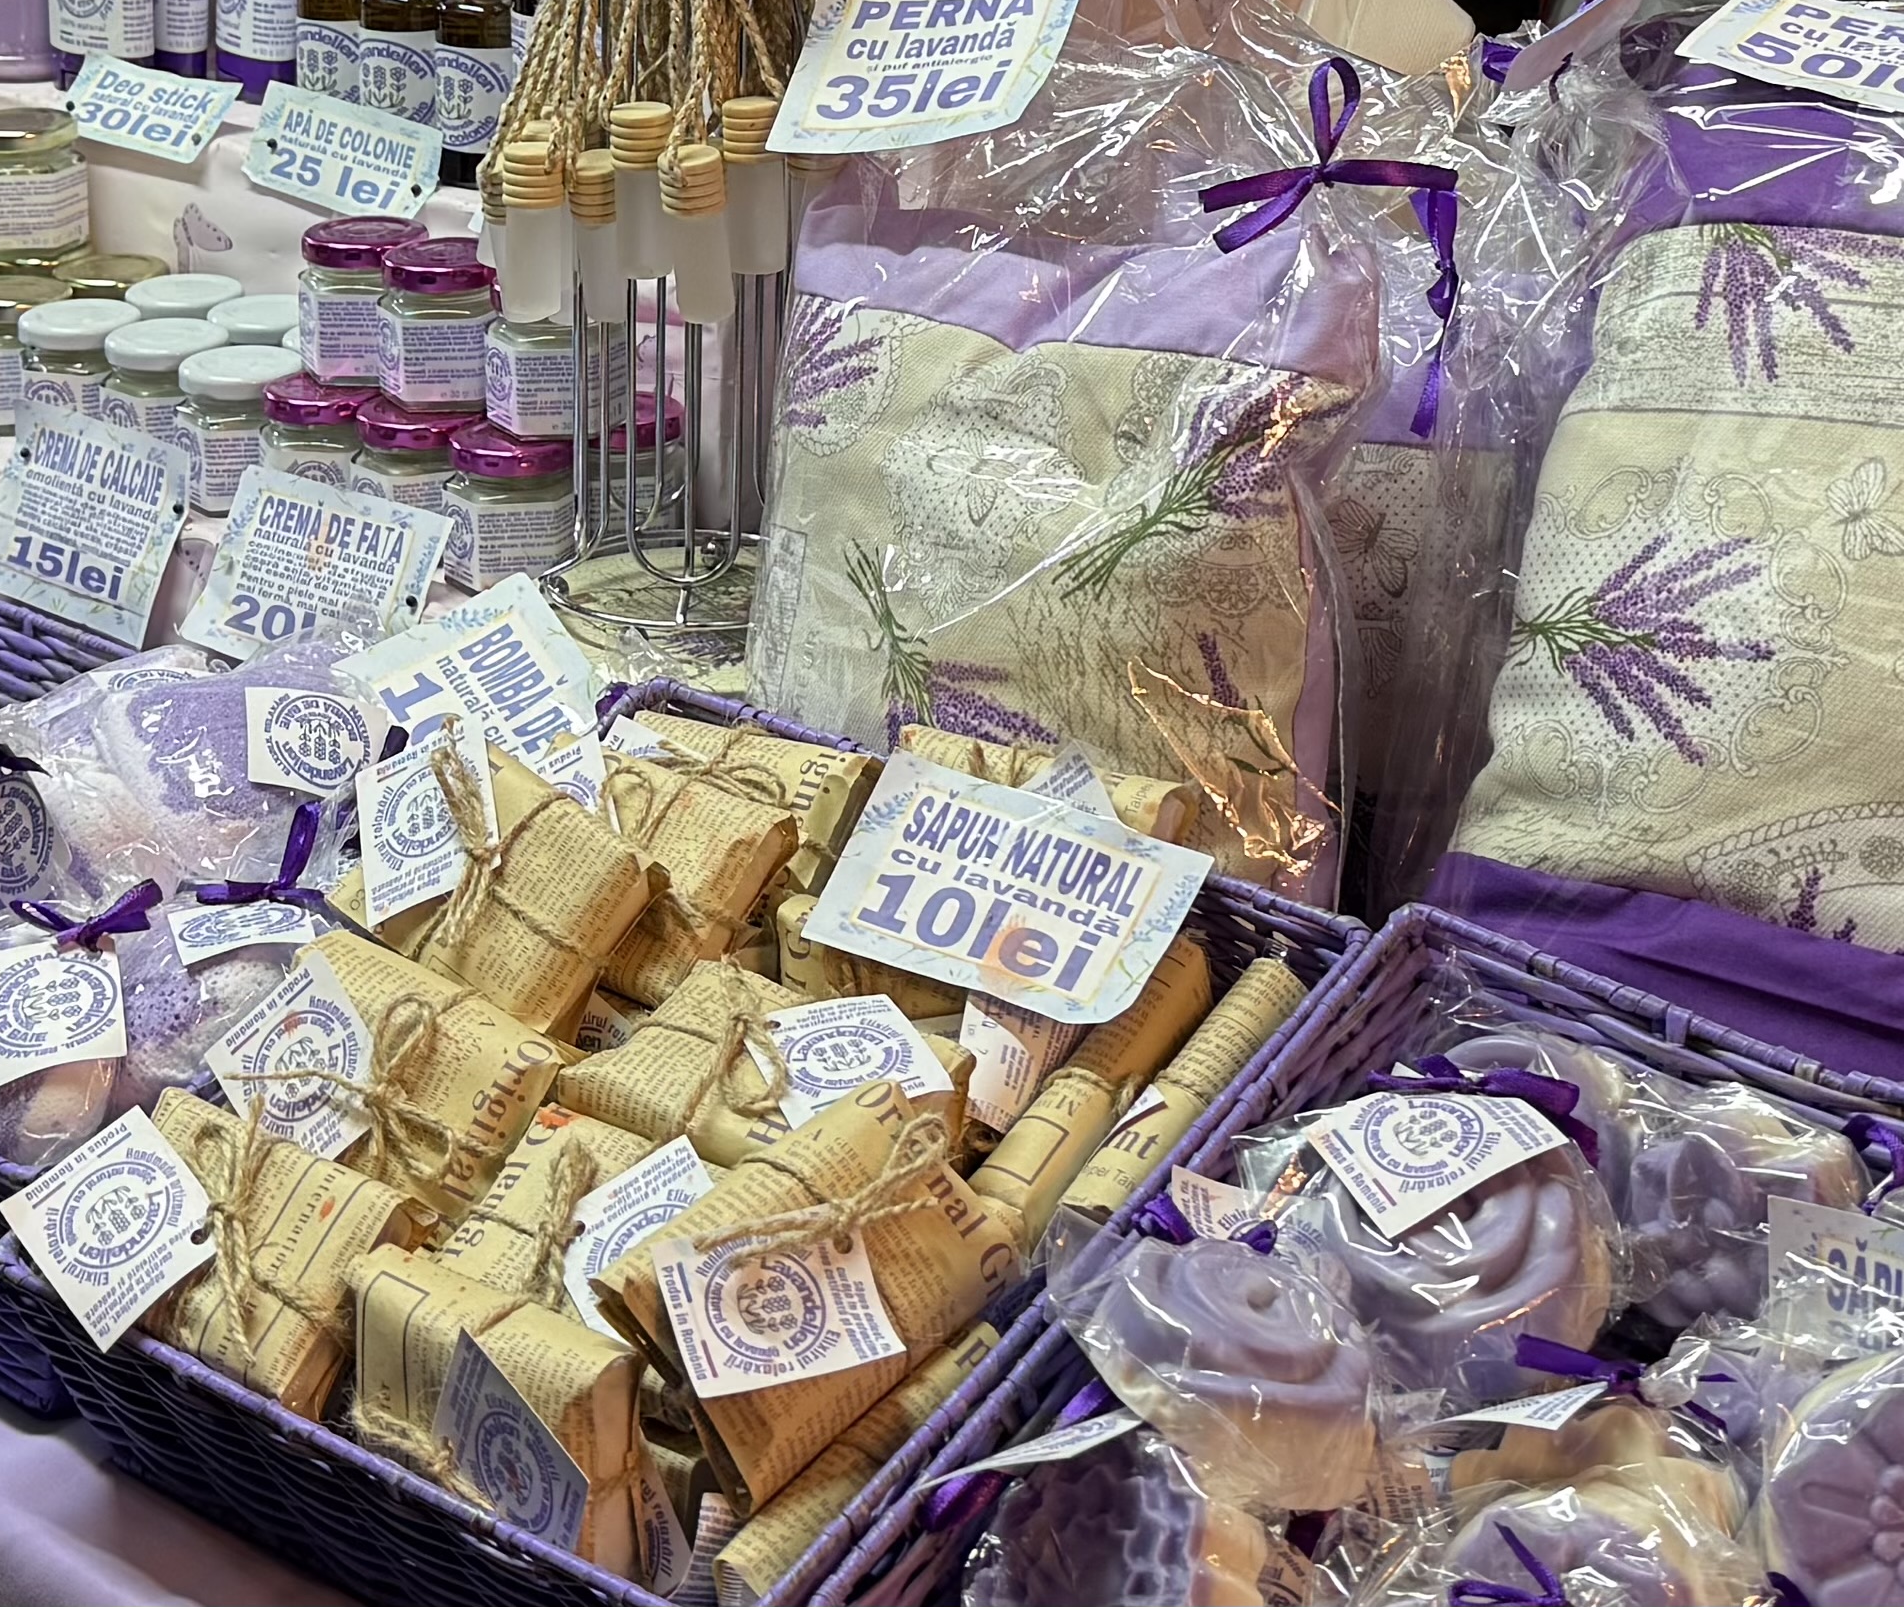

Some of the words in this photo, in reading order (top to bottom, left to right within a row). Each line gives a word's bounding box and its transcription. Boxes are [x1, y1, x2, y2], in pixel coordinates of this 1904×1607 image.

[846, 35, 885, 60] cu
[895, 21, 1017, 60] lavandă
[1779, 19, 1829, 44] cu
[97, 69, 145, 97] Deo
[148, 84, 214, 114] stick
[816, 58, 1014, 120] 35lei
[75, 101, 193, 148] 30lei
[283, 107, 313, 140] APĂ
[315, 117, 336, 142] DE
[342, 125, 416, 170] COLONIE
[270, 147, 322, 188] 25
[334, 164, 401, 211] lei
[330, 150, 348, 162] cu
[351, 153, 409, 182] lavandă
[34, 427, 84, 480] CREMĂ
[77, 442, 103, 484] DE
[87, 490, 106, 505] cu
[108, 494, 160, 525] lavandă
[258, 495, 325, 542] CREMĂ
[325, 512, 356, 548] DE
[6, 535, 124, 602] 15lei
[253, 527, 312, 553] naturală
[315, 544, 335, 558] cu
[338, 547, 396, 576] lavandă
[236, 582, 255, 593] mai
[296, 600, 319, 612] mai
[239, 571, 275, 589] Pentru
[277, 584, 285, 592] o
[318, 593, 339, 608] mai
[457, 622, 569, 723] BOMBĂ
[902, 790, 1012, 867] SĂPUN
[1001, 825, 1144, 918] NATURAL
[890, 847, 943, 875] cu
[953, 859, 1121, 939] lavandă
[857, 873, 1103, 993] 10lei
[277, 966, 311, 997] Produs
[6, 1028, 49, 1043] BAIE
[791, 1027, 885, 1062] Lavandellen
[87, 1122, 128, 1161] Produs
[1407, 1099, 1479, 1157] Lavandellen
[125, 1147, 178, 1184] Handmade
[167, 1177, 187, 1228] artizanal
[43, 1206, 69, 1265] relaxării
[79, 1189, 164, 1265] Lavandellen
[61, 1263, 110, 1287] Elixirul
[661, 1264, 685, 1313] Produs
[759, 1255, 823, 1351] Lavandellen
[722, 1353, 796, 1377] relaxării
[799, 1329, 842, 1371] Elixirul
